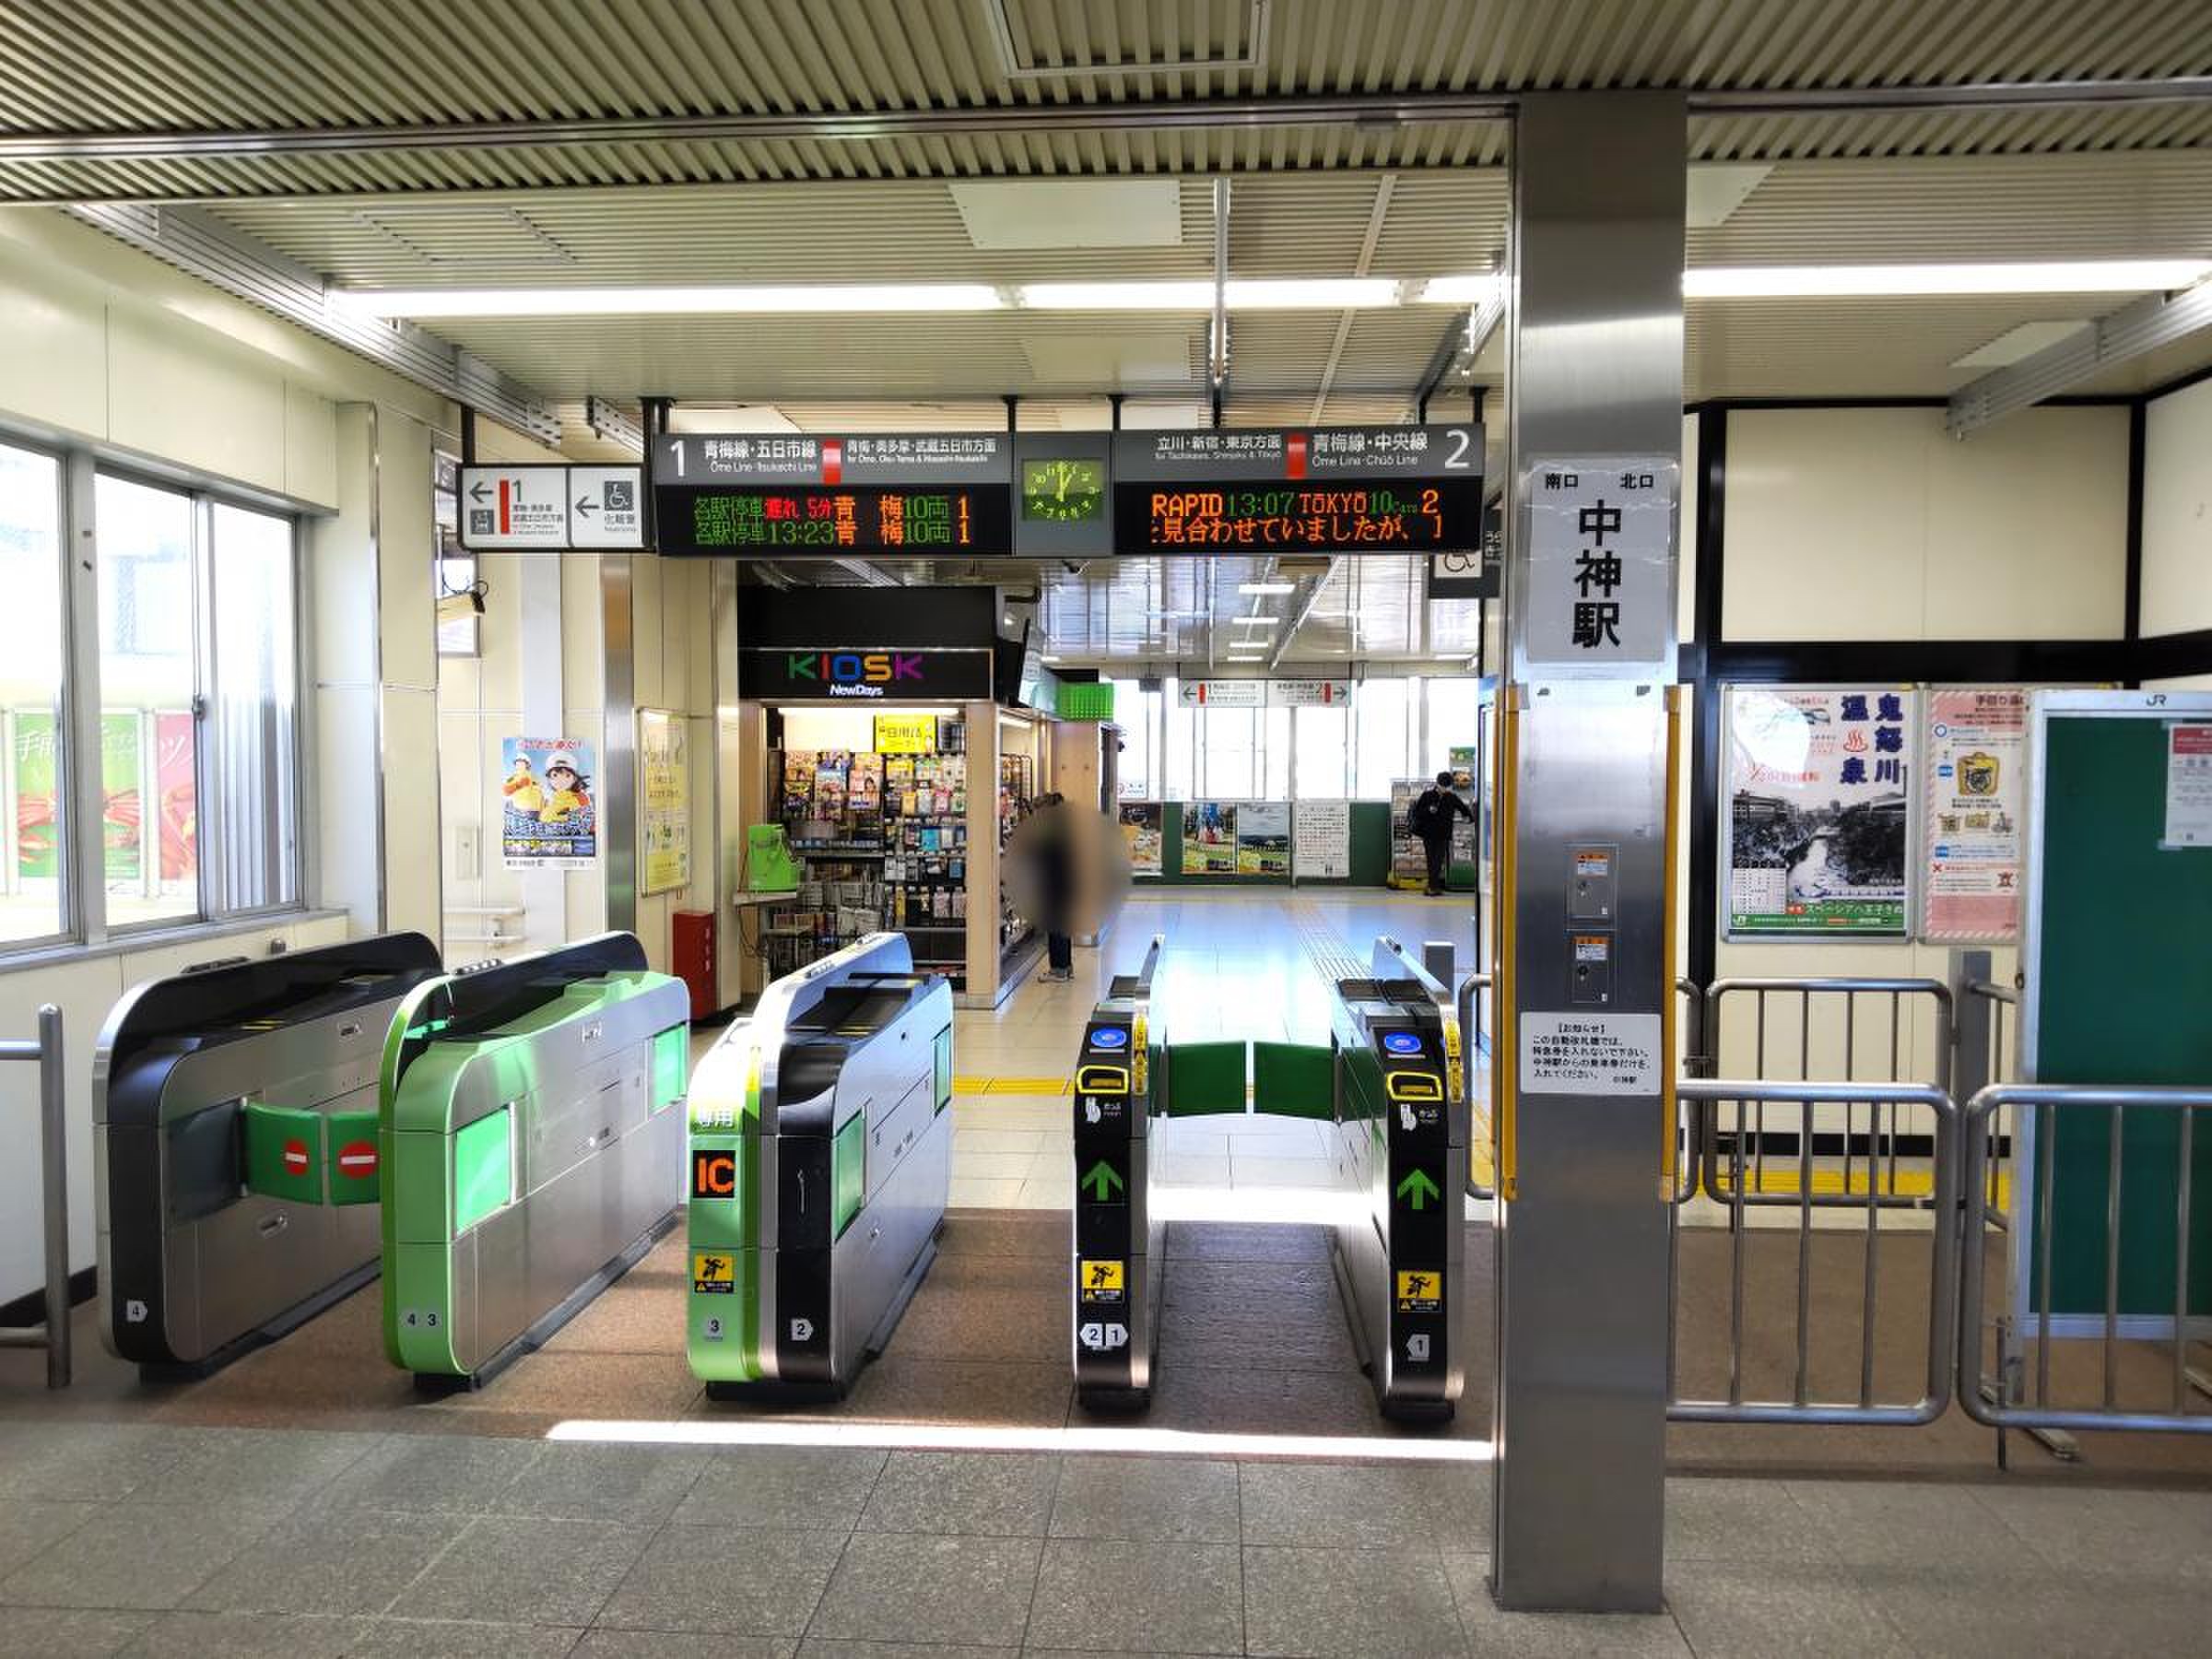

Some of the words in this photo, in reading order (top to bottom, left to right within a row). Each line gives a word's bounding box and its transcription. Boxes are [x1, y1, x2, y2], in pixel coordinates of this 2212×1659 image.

[704, 440, 818, 459] 青梅線・五日市線
[1157, 435, 1282, 451] 立川・新宿・東京方面
[1312, 431, 1429, 453] 青梅線・中央線
[1444, 429, 1470, 469] 2
[670, 440, 685, 477] 1
[512, 479, 521, 502] 1
[1545, 473, 1579, 490] 南口
[1619, 473, 1654, 489] 北口
[959, 496, 970, 520] 1
[1151, 492, 1223, 517] RAPID
[1227, 492, 1295, 517] 13:07
[1421, 488, 1439, 513] 2
[694, 521, 766, 546] 各駅停車
[767, 521, 835, 545] 13:23
[959, 521, 971, 545] 1
[1571, 499, 1622, 649] 中神駅
[788, 653, 924, 681] KIOSK
[830, 684, 884, 697] NewDays
[2146, 694, 2167, 706] JR
[1841, 694, 1869, 784] 温泉
[1875, 693, 1903, 784] 鬼怒川
[697, 1157, 735, 1194] IC
[427, 1312, 437, 1326] 3
[711, 1319, 720, 1333] 3
[796, 1323, 806, 1336] 2
[1089, 1328, 1099, 1341] 2
[1417, 1339, 1424, 1352] 1
